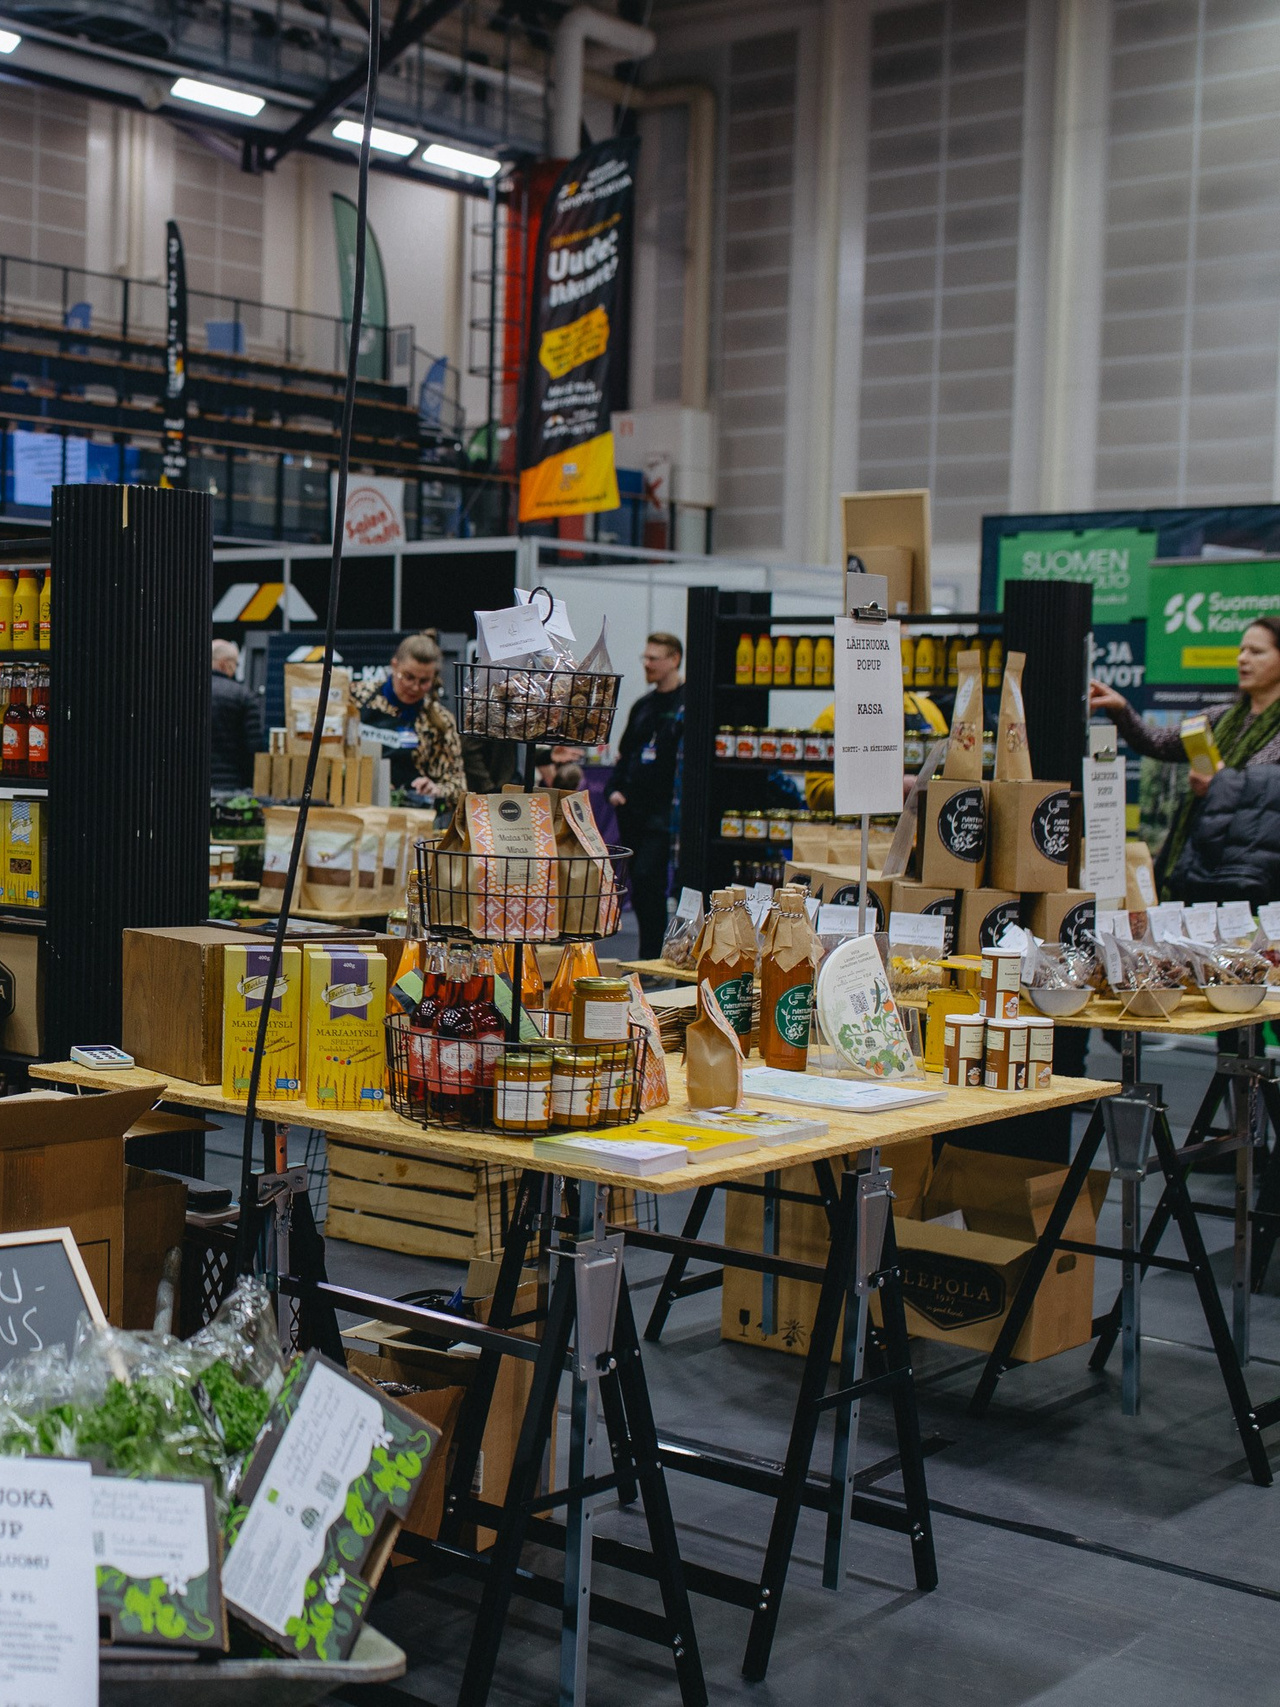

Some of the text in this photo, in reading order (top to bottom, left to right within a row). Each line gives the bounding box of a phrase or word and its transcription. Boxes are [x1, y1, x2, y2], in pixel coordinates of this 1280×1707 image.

[1022, 549, 1129, 575] SUOMEN
[846, 636, 890, 650] LÄHIRUOKA
[857, 660, 881, 670] POPUP
[857, 703, 883, 715] KASSA
[232, 1020, 293, 1028] MARJMYSLI
[316, 1028, 379, 1038] MARJAMYSLI
[904, 1269, 991, 1302] LEPOLA
